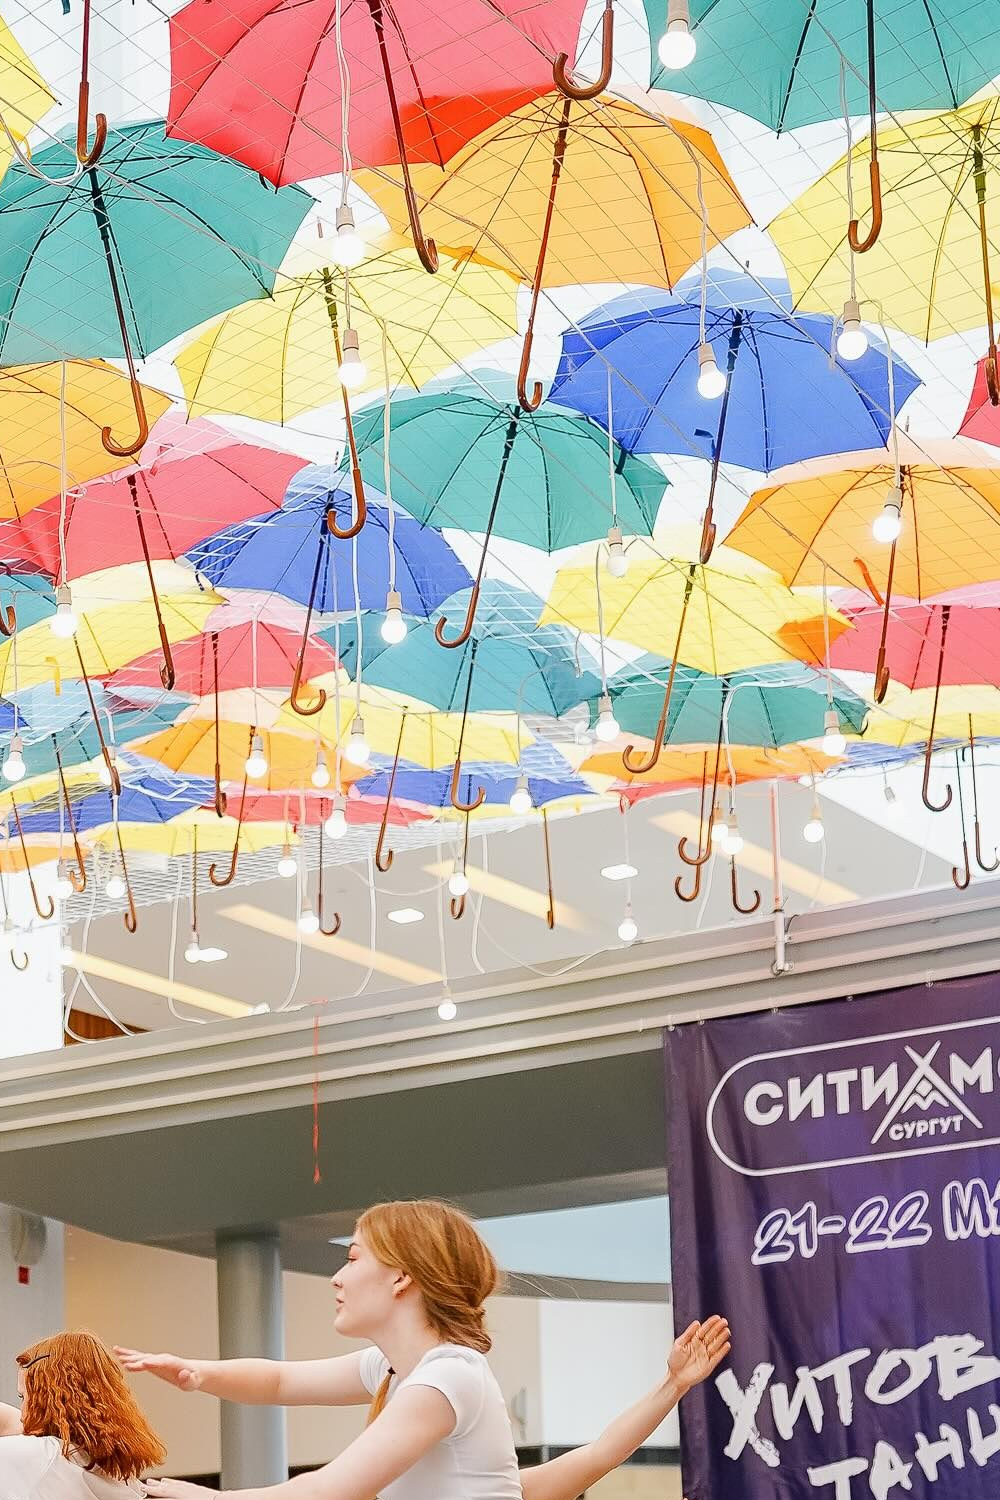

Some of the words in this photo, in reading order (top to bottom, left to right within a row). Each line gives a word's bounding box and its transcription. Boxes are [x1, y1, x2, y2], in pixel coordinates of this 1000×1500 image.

[743, 1061, 899, 1126] СИТИ
[888, 1114, 964, 1141] СУРГУТ
[750, 1190, 933, 1266] 21-22
